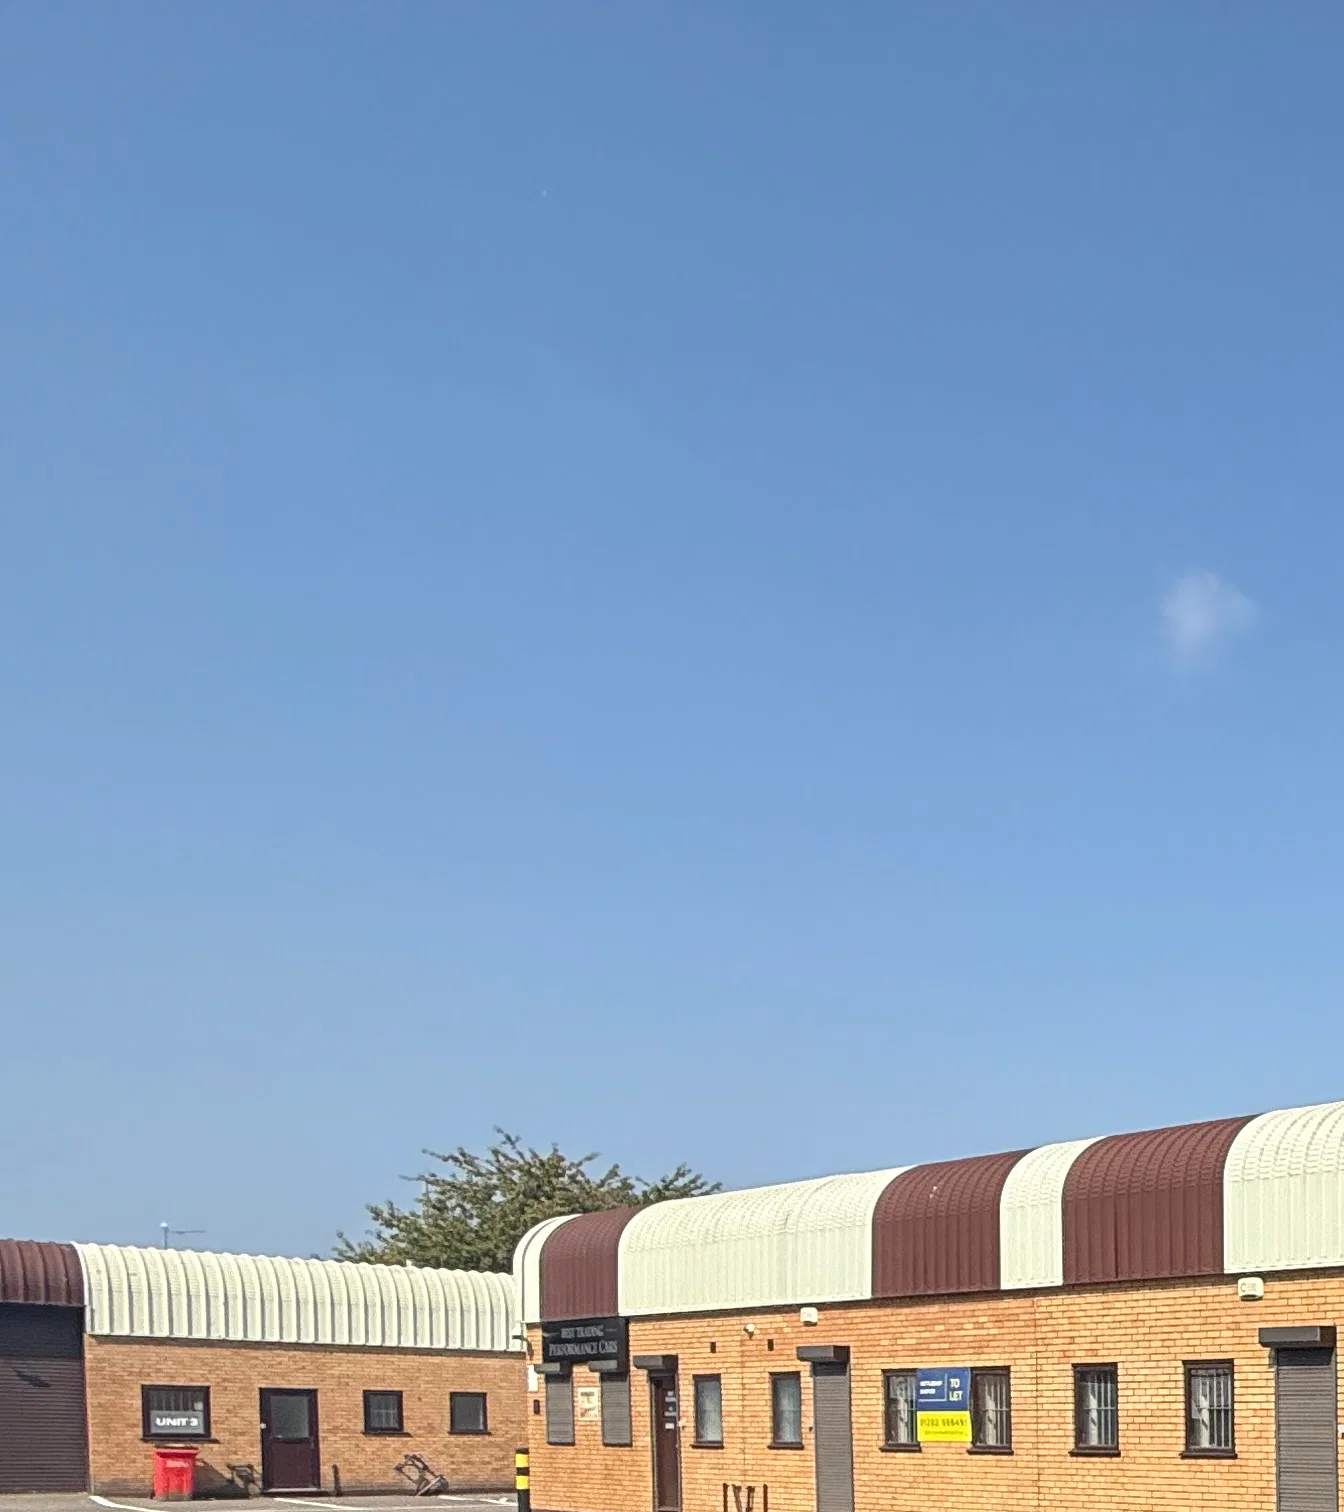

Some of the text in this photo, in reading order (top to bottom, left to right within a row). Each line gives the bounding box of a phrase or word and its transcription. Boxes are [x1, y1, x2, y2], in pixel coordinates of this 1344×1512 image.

[549, 1340, 618, 1356] PERFORMANCE CARS
[949, 1378, 961, 1389] TO
[949, 1390, 963, 1401] LET
[155, 1417, 199, 1427] UNIT 3
